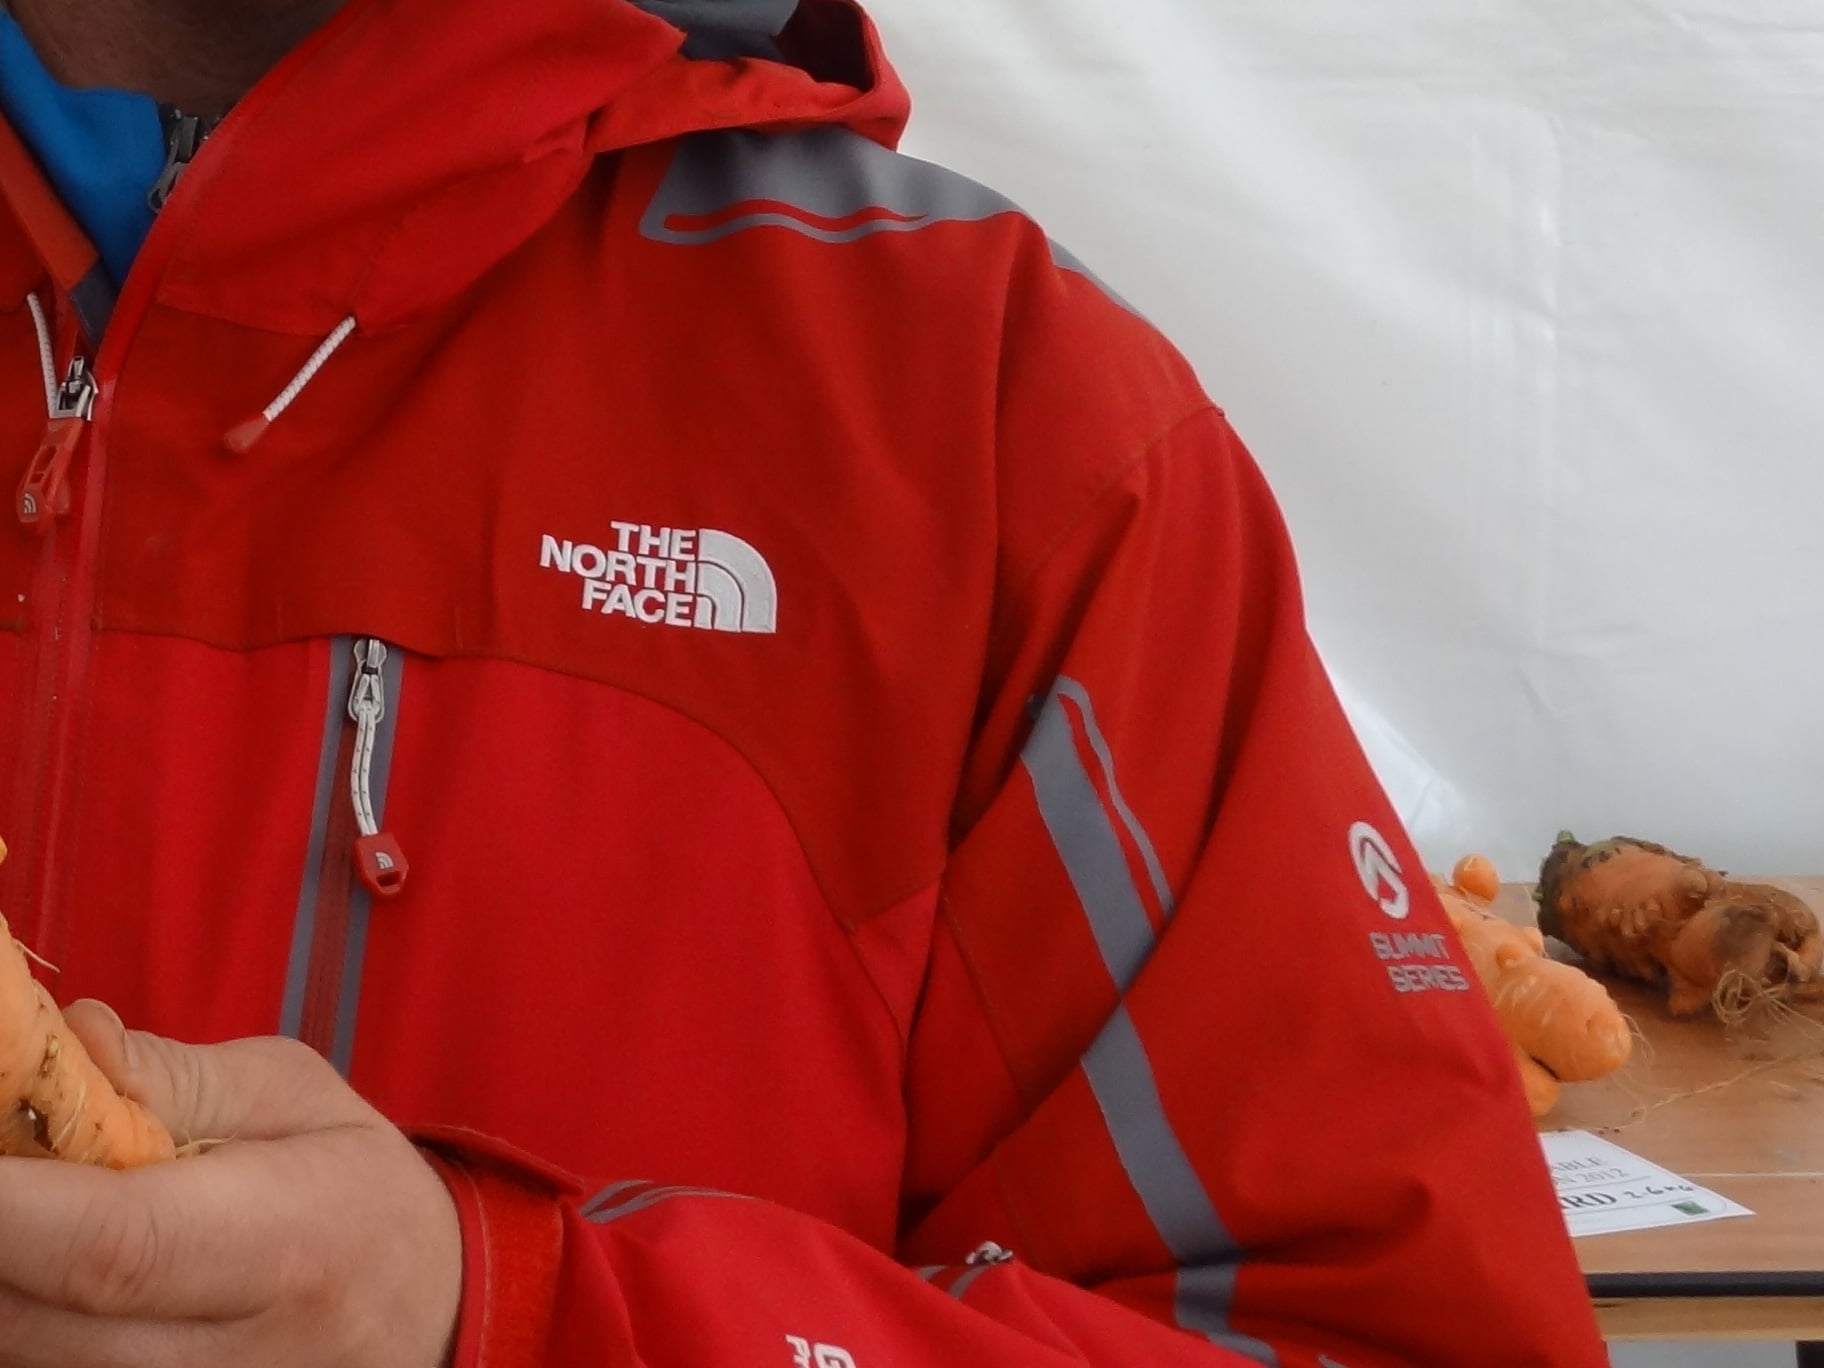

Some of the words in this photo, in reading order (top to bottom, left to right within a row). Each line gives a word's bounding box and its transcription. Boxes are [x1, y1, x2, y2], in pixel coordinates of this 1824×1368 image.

[610, 520, 696, 562] THE
[539, 534, 697, 594] NORTH
[581, 578, 693, 628] FACE
[1370, 931, 1450, 961] SUMMIT
[1387, 963, 1470, 993] SERIES
[1578, 1168, 1630, 1183] 2012
